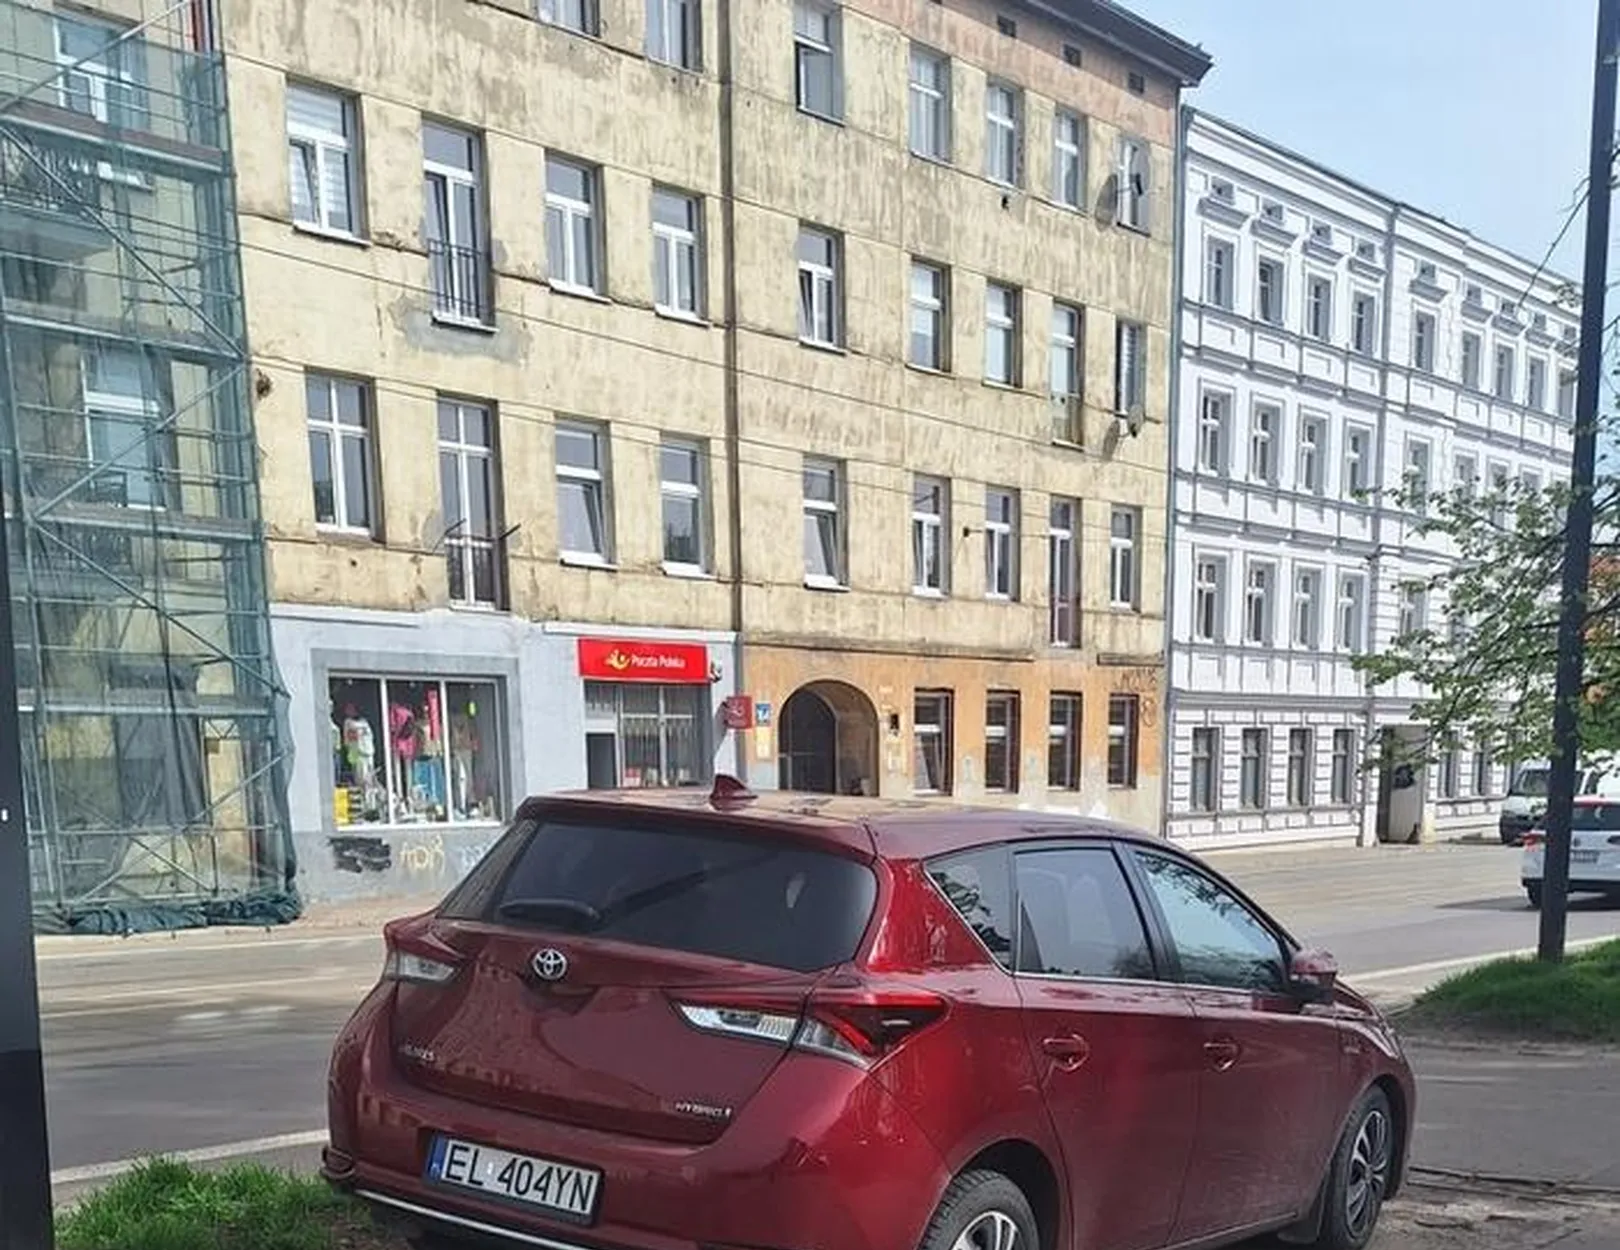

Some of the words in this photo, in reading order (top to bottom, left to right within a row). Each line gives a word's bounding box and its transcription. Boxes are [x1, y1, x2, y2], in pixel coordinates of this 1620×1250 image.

[631, 653, 658, 668] Poczta
[659, 654, 686, 669] Polska
[446, 1144, 484, 1186] EL
[498, 1157, 594, 1211] 404YN
